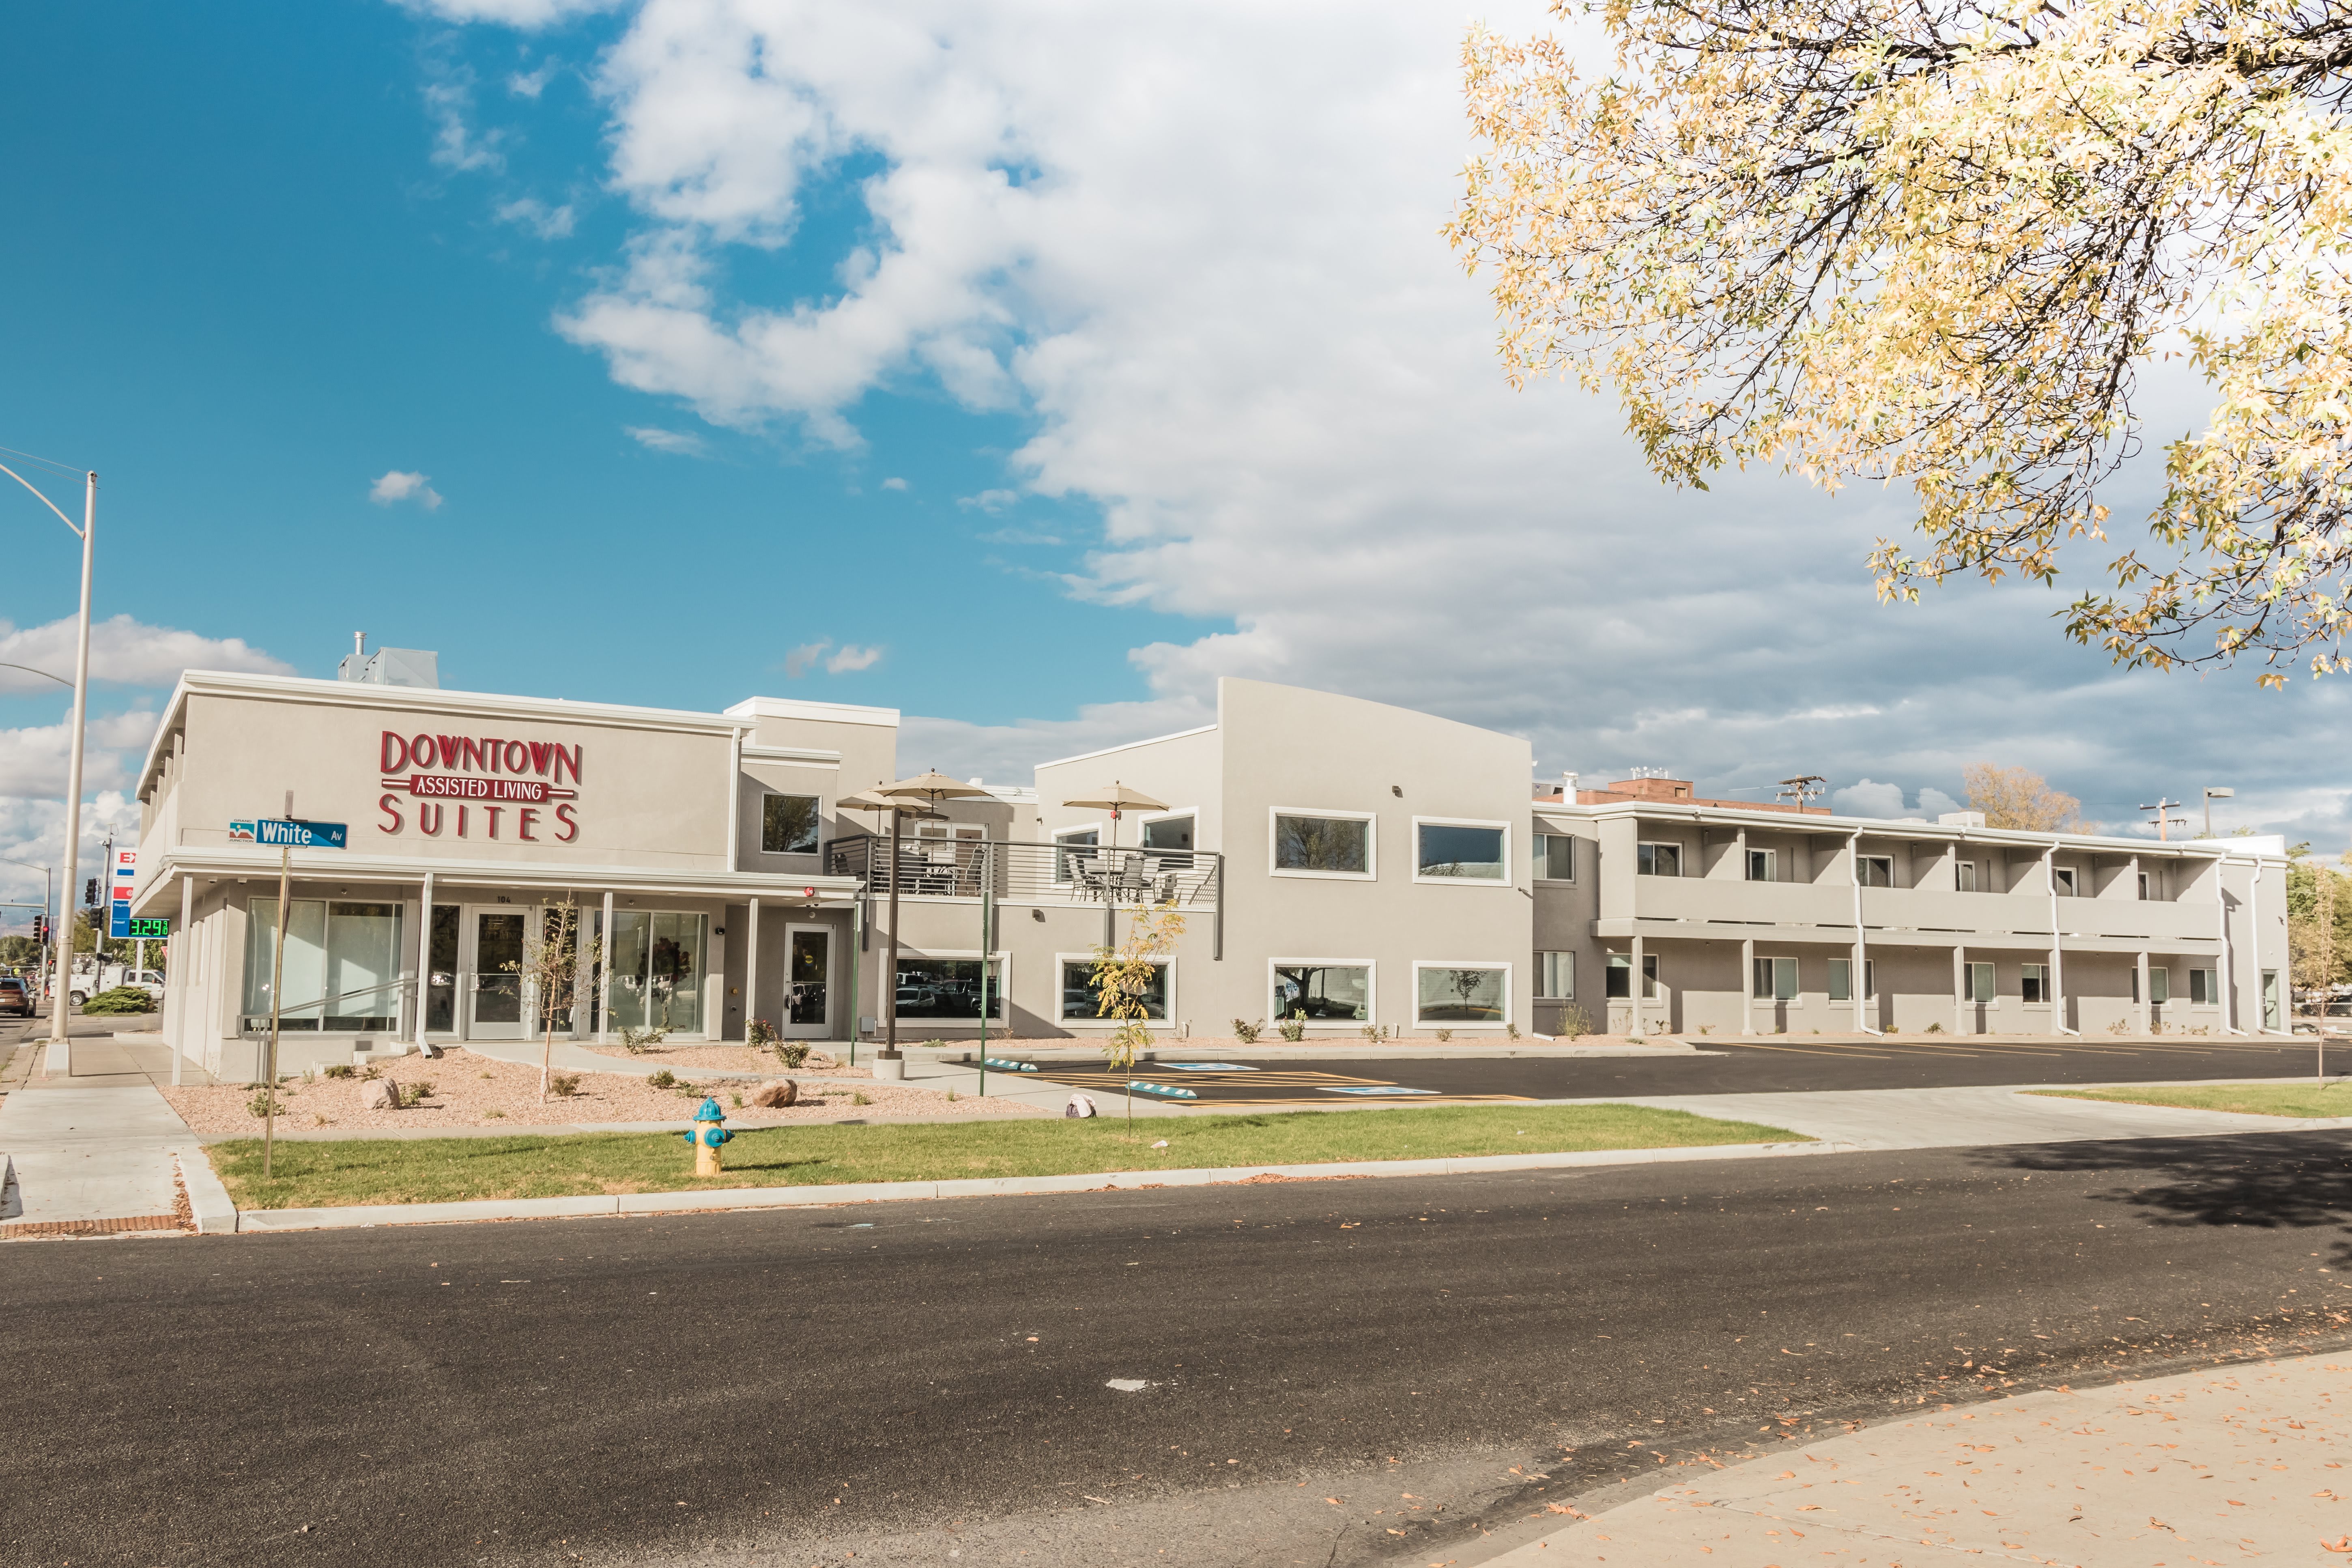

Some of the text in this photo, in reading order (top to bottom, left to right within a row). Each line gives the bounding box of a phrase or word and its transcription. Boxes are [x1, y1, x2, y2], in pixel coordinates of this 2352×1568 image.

[381, 731, 578, 783] DOWNTOWN
[416, 776, 542, 800] ASSISTED LIVING
[378, 794, 575, 841] SUITES
[262, 822, 342, 844] White Av
[131, 920, 161, 936] 3.29
